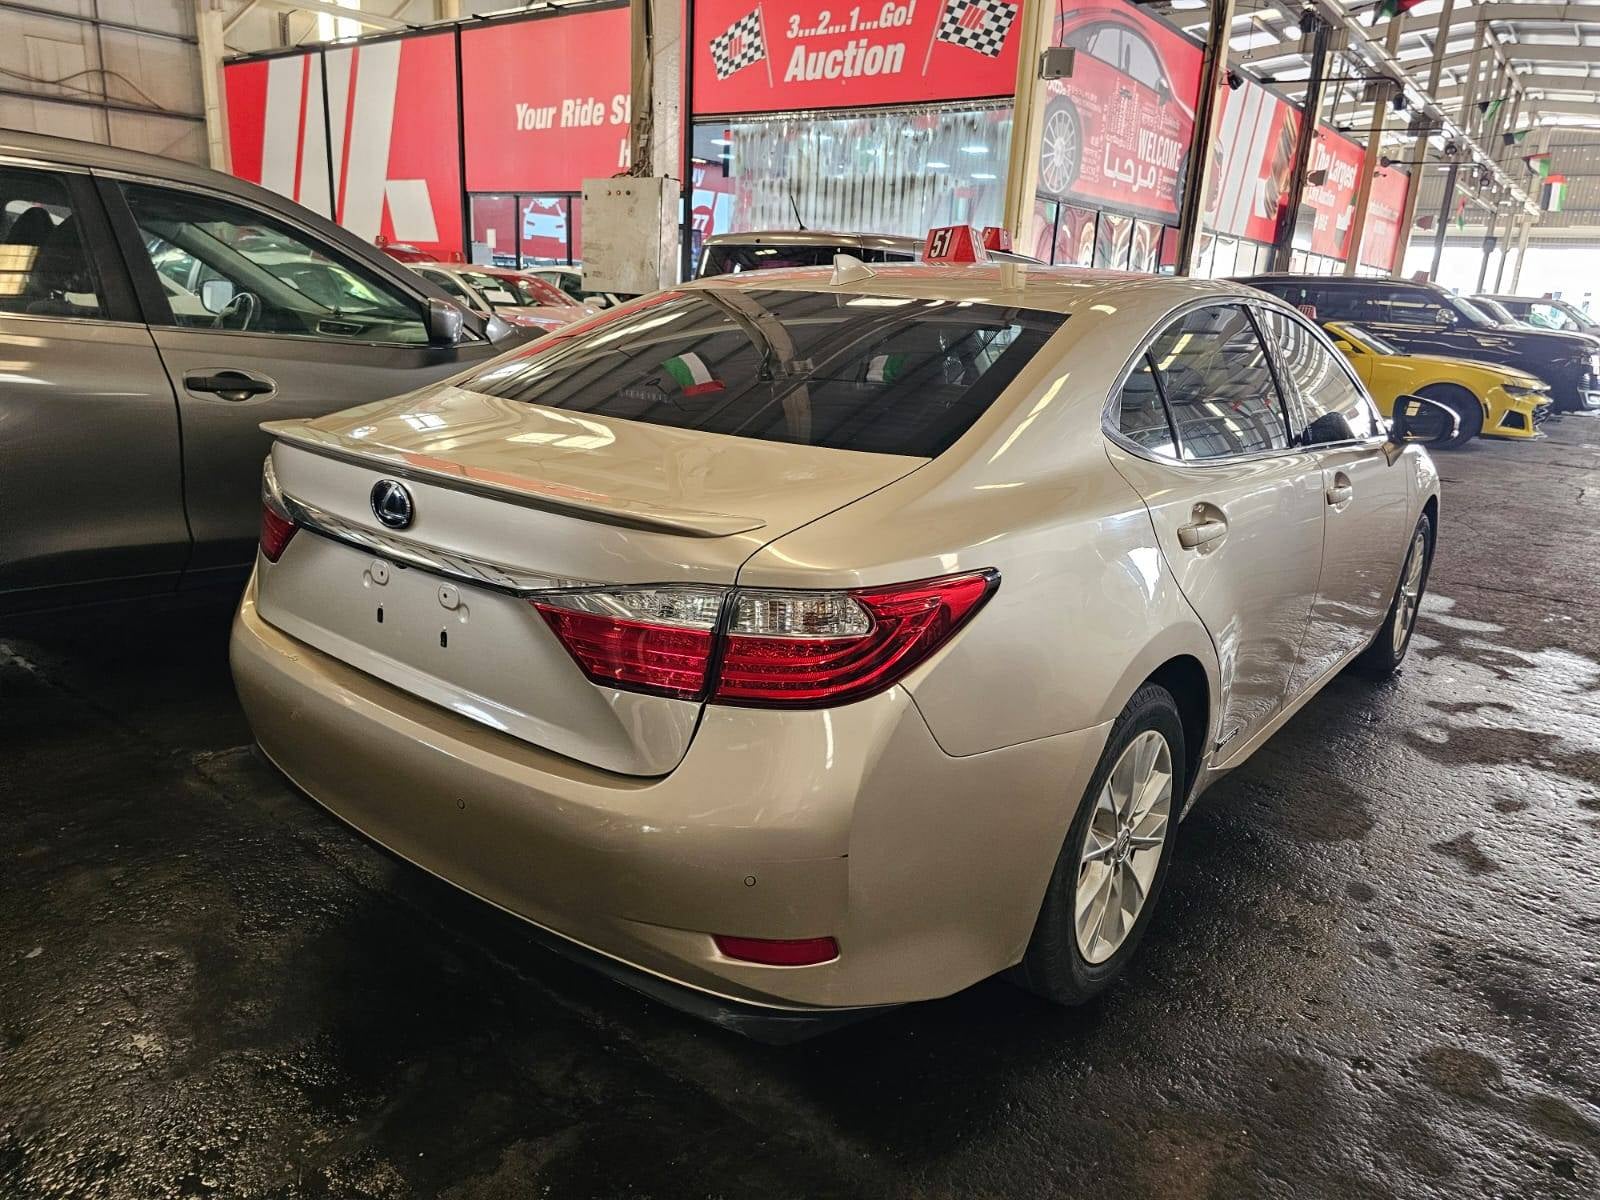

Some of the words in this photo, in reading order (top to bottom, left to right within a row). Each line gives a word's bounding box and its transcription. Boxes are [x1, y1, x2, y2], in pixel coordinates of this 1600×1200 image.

[784, 38, 906, 83] Auction
[515, 102, 558, 131] Your
[560, 97, 606, 128] Ride
[1103, 142, 1156, 192] مرحبا
[1138, 127, 1182, 172] WELCOME
[930, 228, 954, 258] 51
